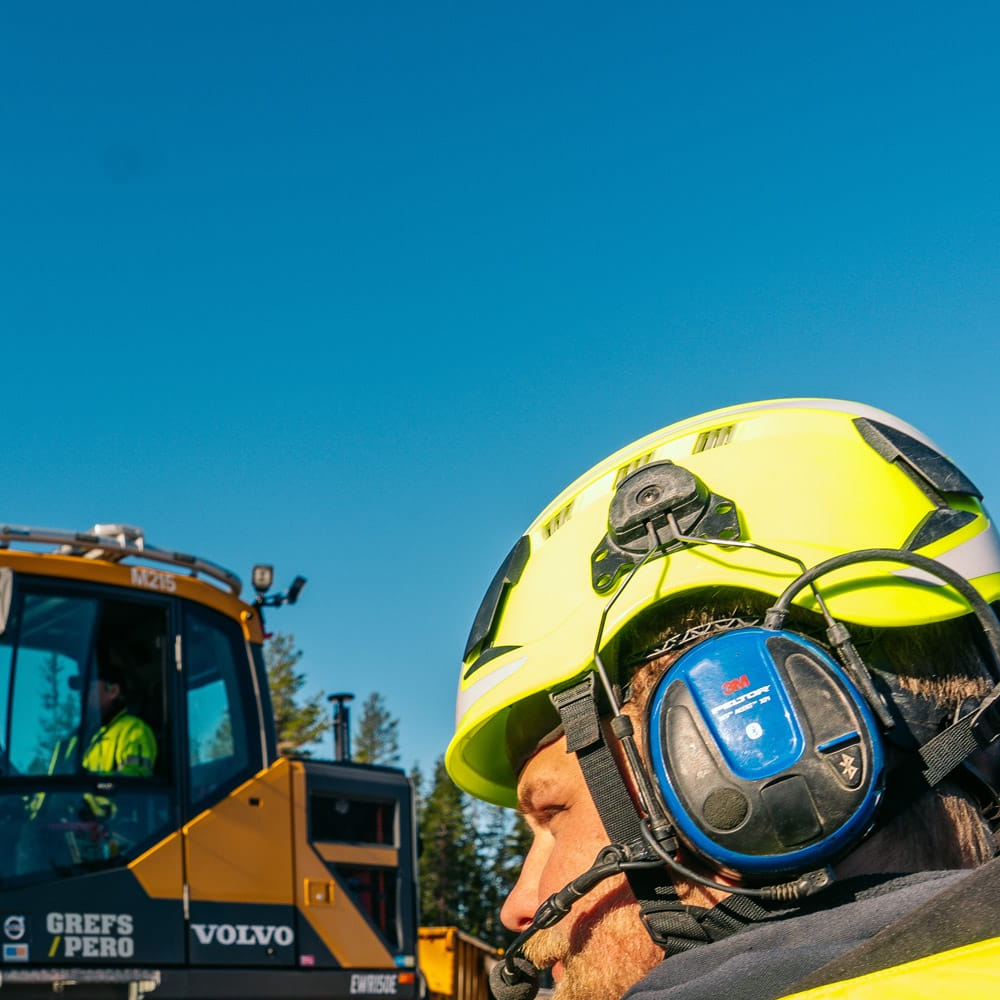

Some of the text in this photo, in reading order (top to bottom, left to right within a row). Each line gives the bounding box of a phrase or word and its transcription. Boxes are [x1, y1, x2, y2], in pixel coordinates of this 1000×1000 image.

[131, 567, 176, 592] M215
[721, 674, 750, 695] 3M
[46, 912, 134, 935] GREFS
[190, 923, 294, 946] VOLVO
